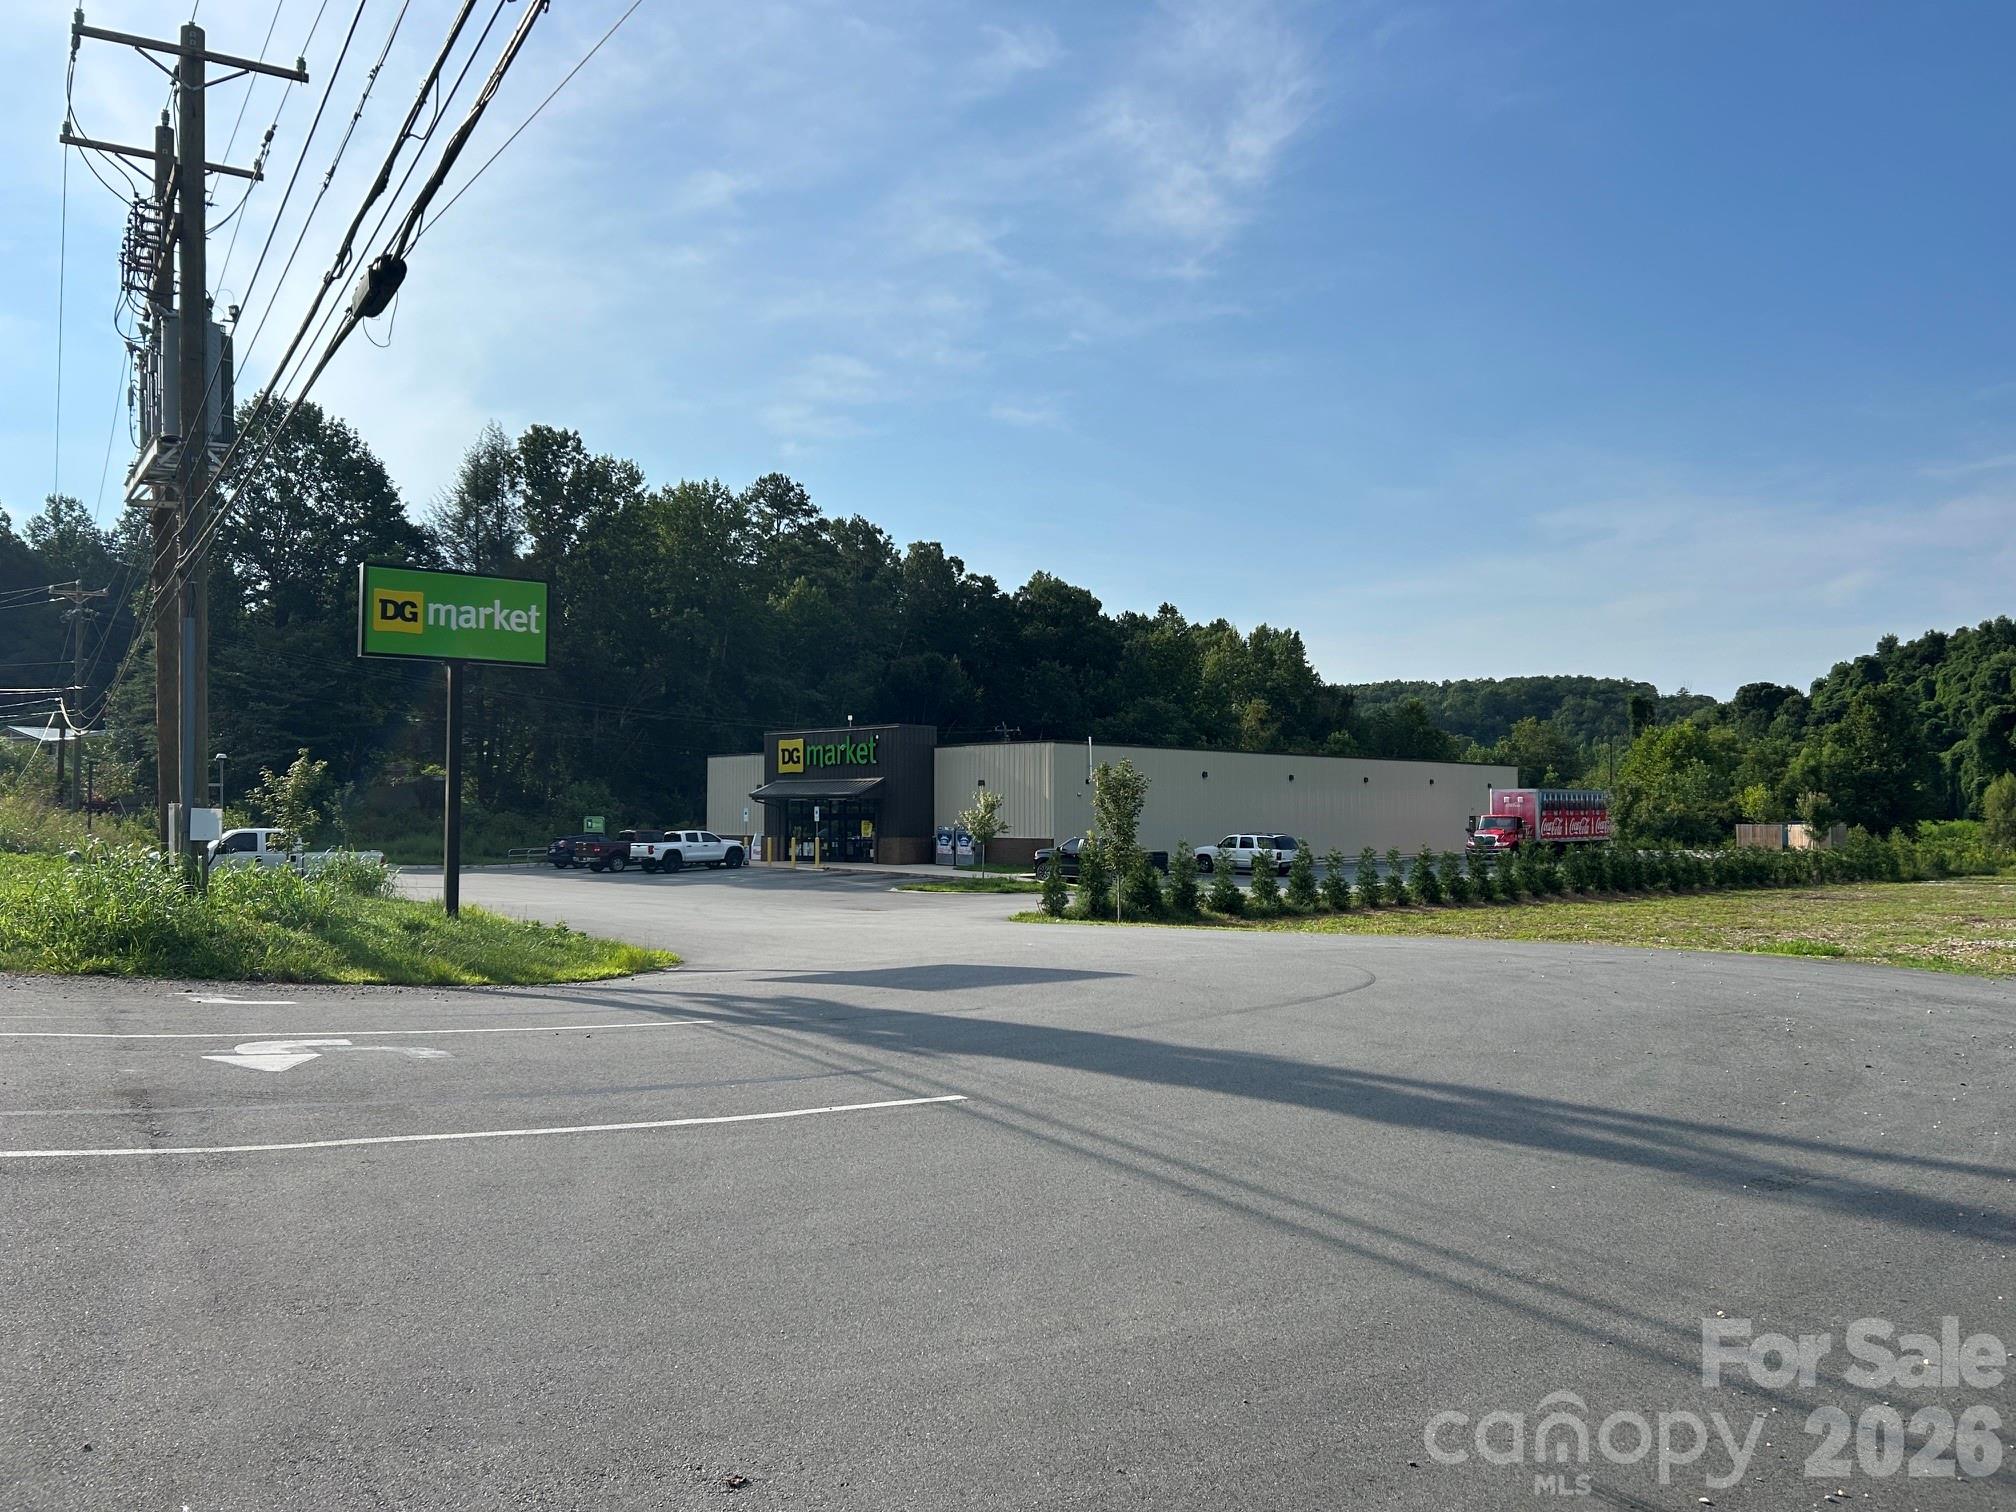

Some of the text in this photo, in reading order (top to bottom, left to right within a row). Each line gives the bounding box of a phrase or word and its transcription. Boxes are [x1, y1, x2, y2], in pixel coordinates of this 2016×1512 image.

[378, 598, 541, 634] DG market
[780, 735, 878, 769] DG market
